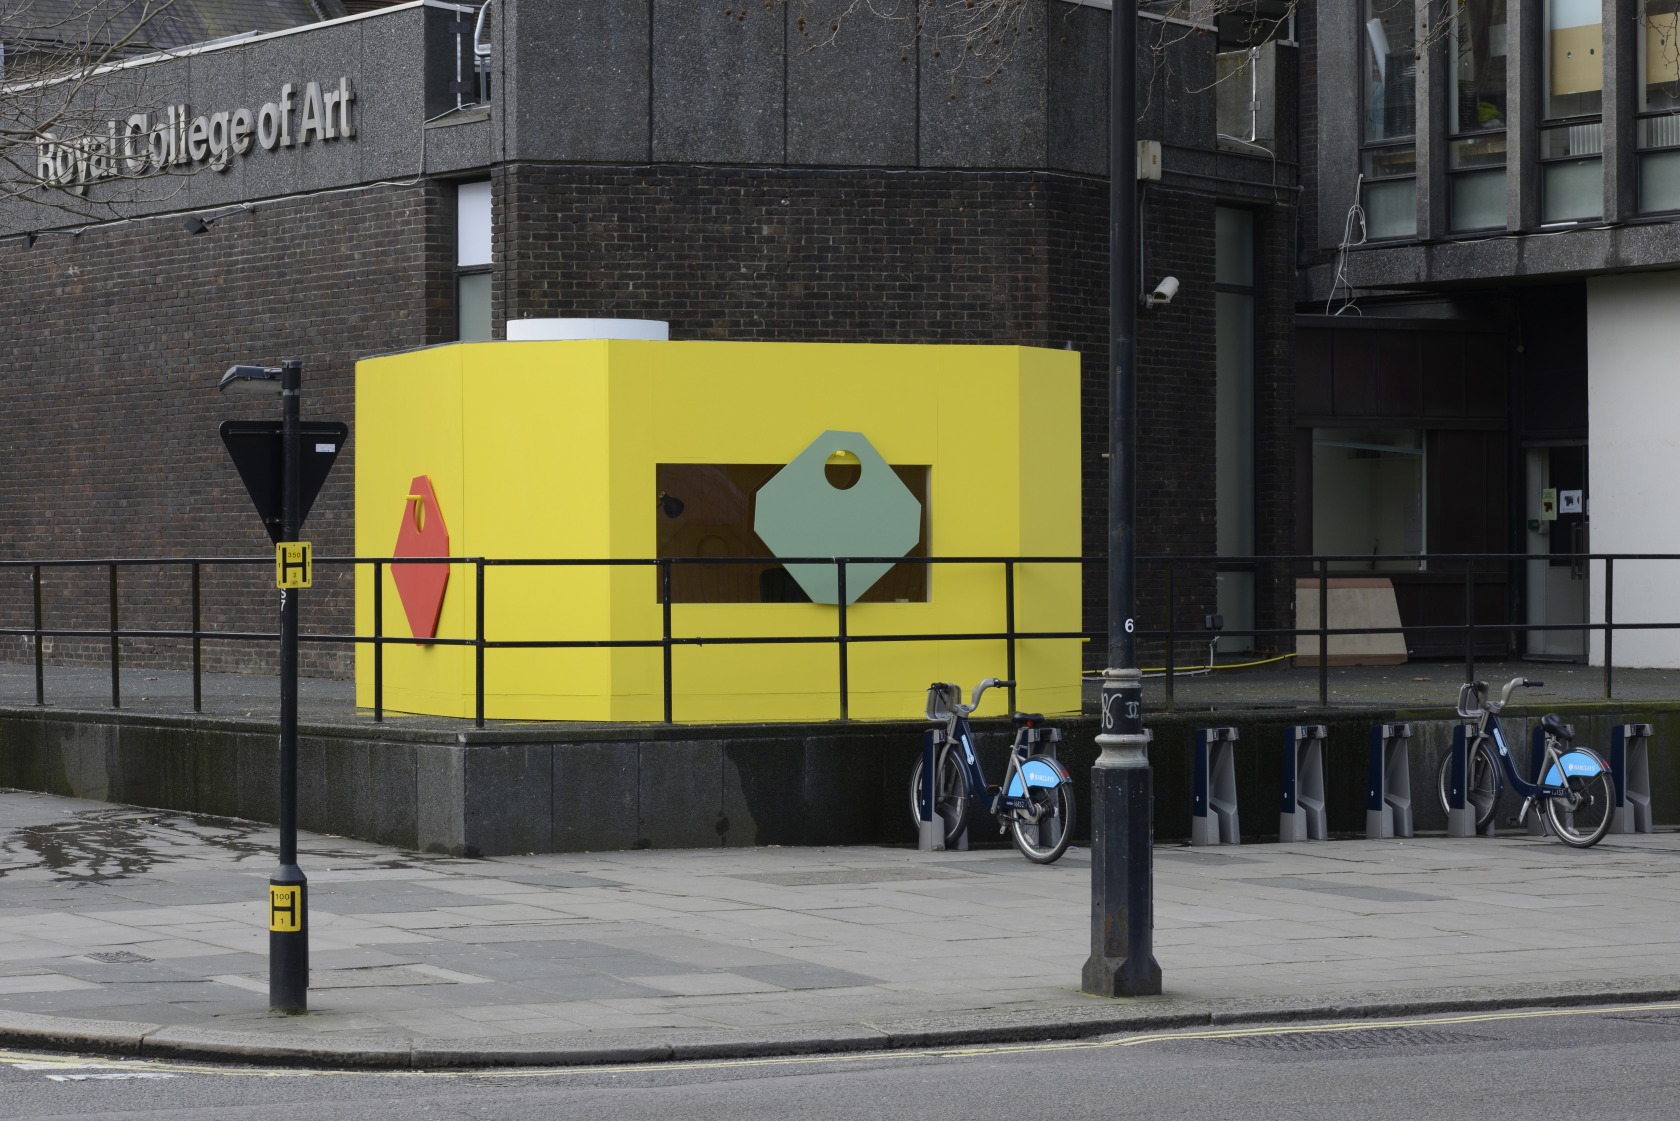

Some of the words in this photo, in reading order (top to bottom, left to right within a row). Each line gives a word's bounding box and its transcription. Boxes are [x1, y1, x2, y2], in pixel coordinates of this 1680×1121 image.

[35, 118, 119, 195] Royal
[125, 104, 255, 172] College
[258, 83, 297, 150] of
[299, 76, 355, 143] Art
[282, 547, 306, 583] H
[1125, 618, 1134, 632] 6
[271, 890, 295, 926] H
